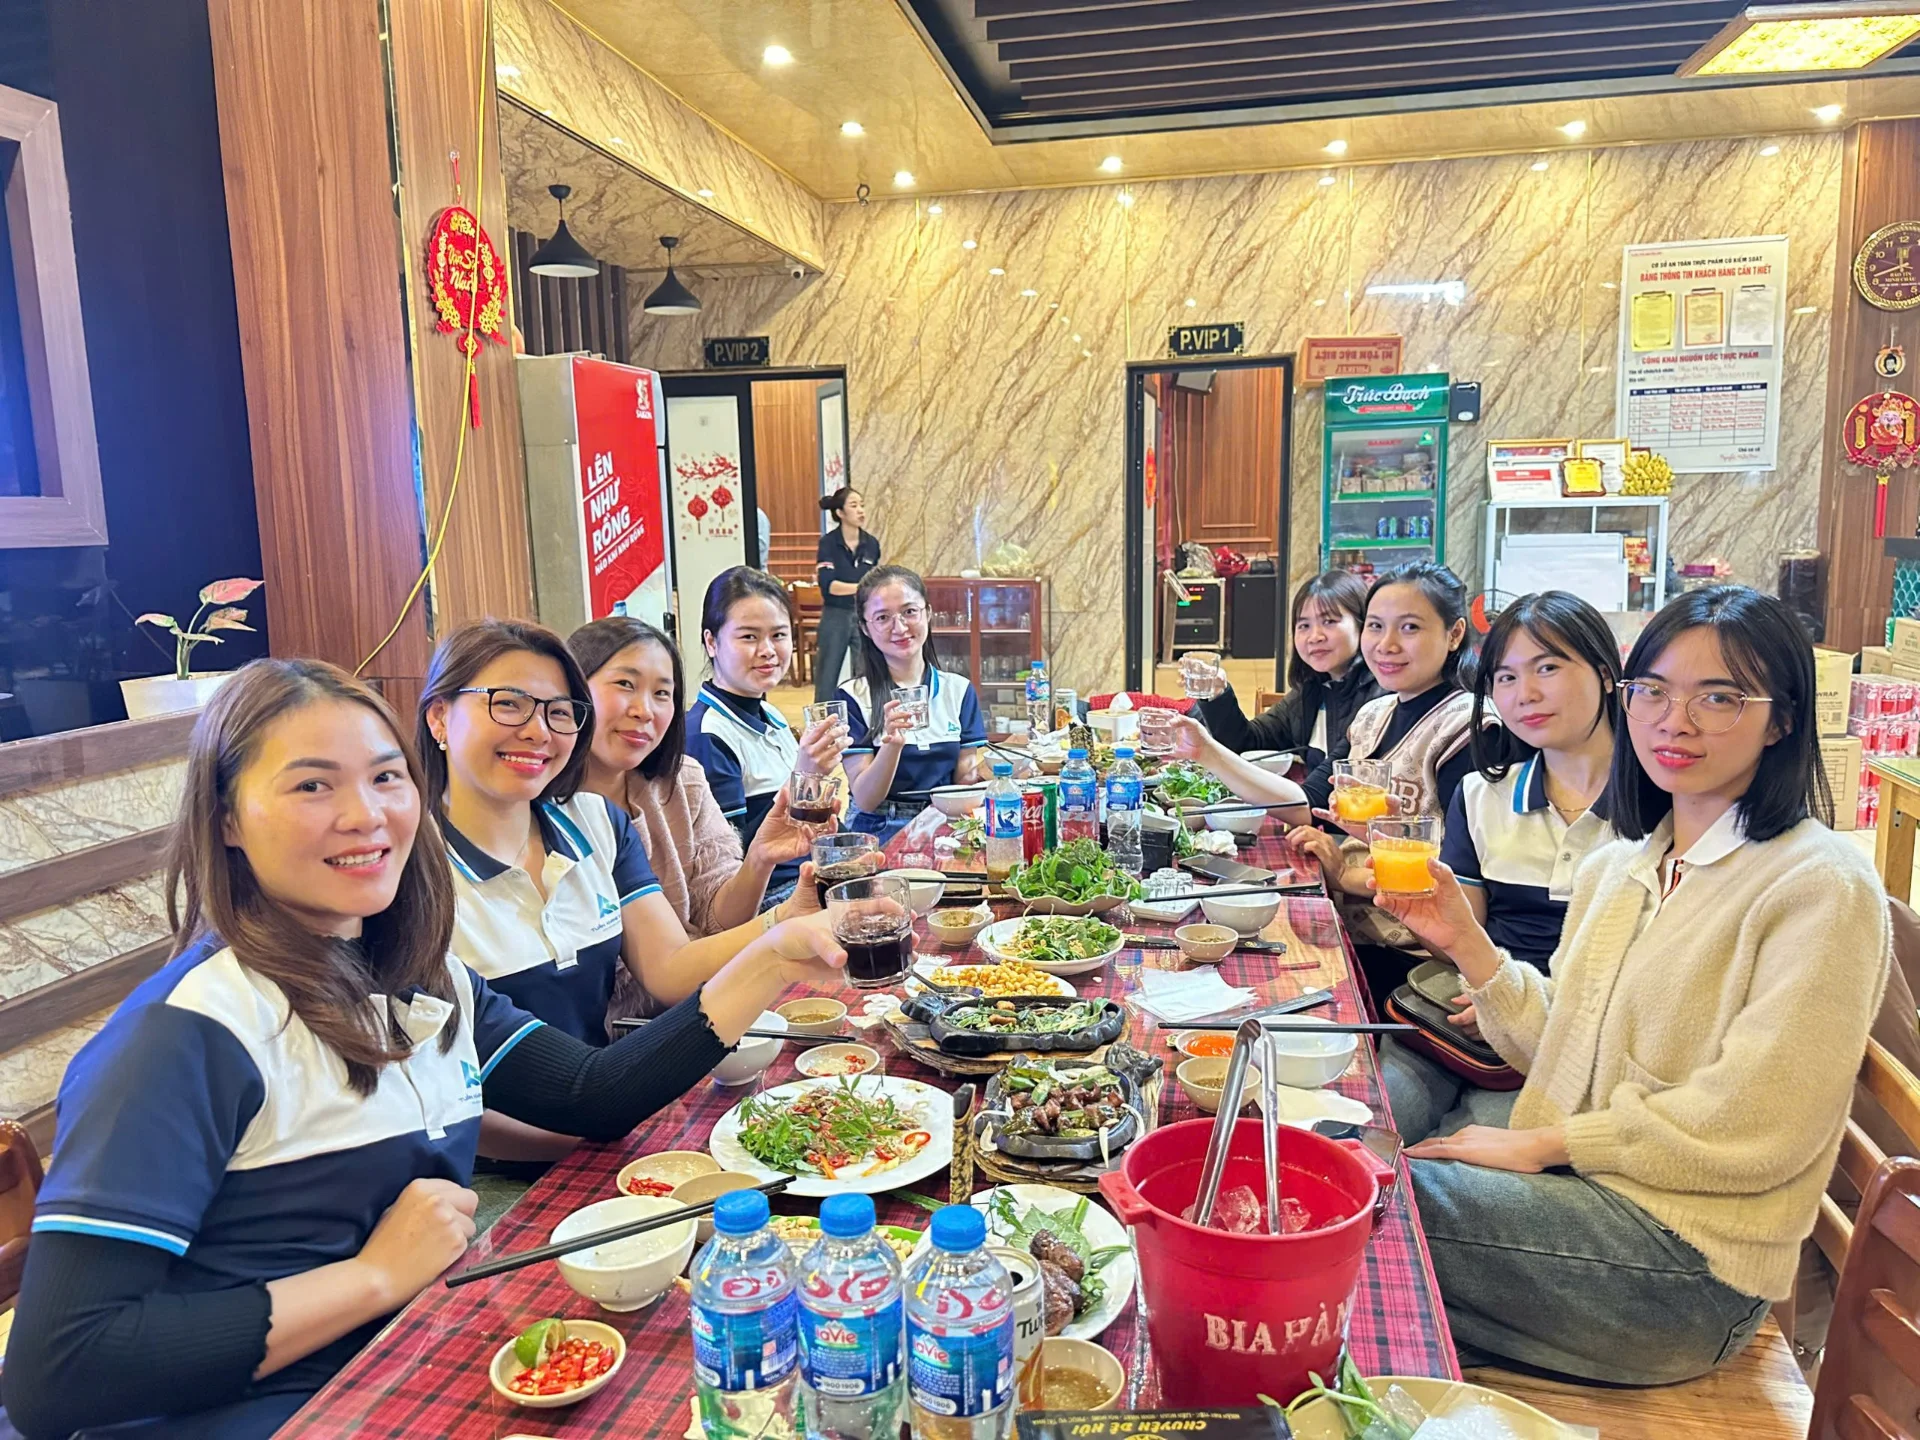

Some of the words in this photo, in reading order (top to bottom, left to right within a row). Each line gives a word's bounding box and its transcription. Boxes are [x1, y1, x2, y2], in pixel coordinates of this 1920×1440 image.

[1885, 240, 1894, 248] 11
[1899, 235, 1910, 243] 12
[1875, 250, 1885, 259] 10
[1640, 271, 1658, 282] BẢNG
[1659, 270, 1681, 281] THÔNG
[1682, 270, 1693, 280] TIN
[1694, 267, 1717, 279] KHÁCH
[1718, 266, 1736, 277] HÀNG
[1737, 265, 1751, 276] CẦN
[1869, 264, 1876, 272] 9
[1895, 289, 1902, 298] 6
[1180, 328, 1220, 351] P.VIP
[1221, 327, 1230, 348] 1
[714, 342, 749, 362] P.VIP
[750, 341, 759, 361] 2
[1662, 355, 1678, 363] KHAI
[1343, 385, 1382, 404] Trúc
[1382, 382, 1430, 404] Bạch
[587, 451, 614, 491] LÊN
[590, 477, 621, 523] NHƯ
[592, 505, 631, 556] RỒNG
[1203, 1312, 1278, 1356] BIA
